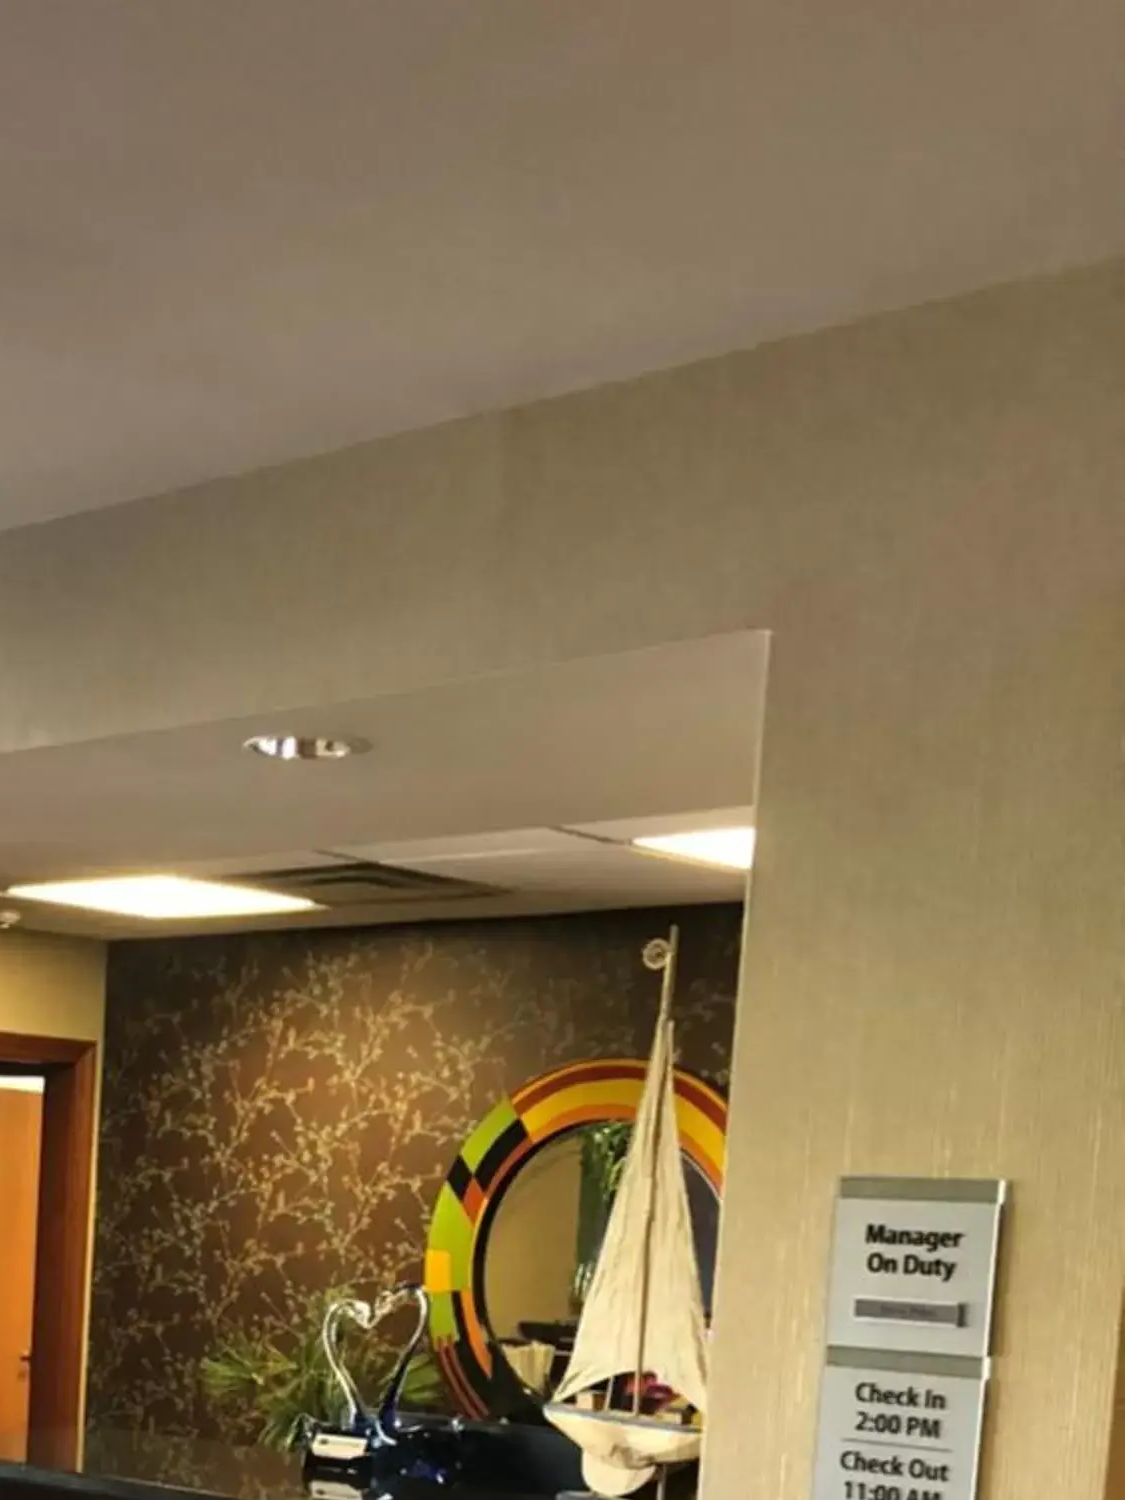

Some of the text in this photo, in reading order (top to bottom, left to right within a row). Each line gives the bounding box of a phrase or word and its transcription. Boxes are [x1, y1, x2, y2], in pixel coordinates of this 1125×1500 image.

[865, 1223, 963, 1253] Manager
[866, 1252, 957, 1283] On Duty
[854, 1381, 946, 1411] Check In
[854, 1411, 942, 1438] 2:00 PM
[839, 1450, 949, 1482] Check Out
